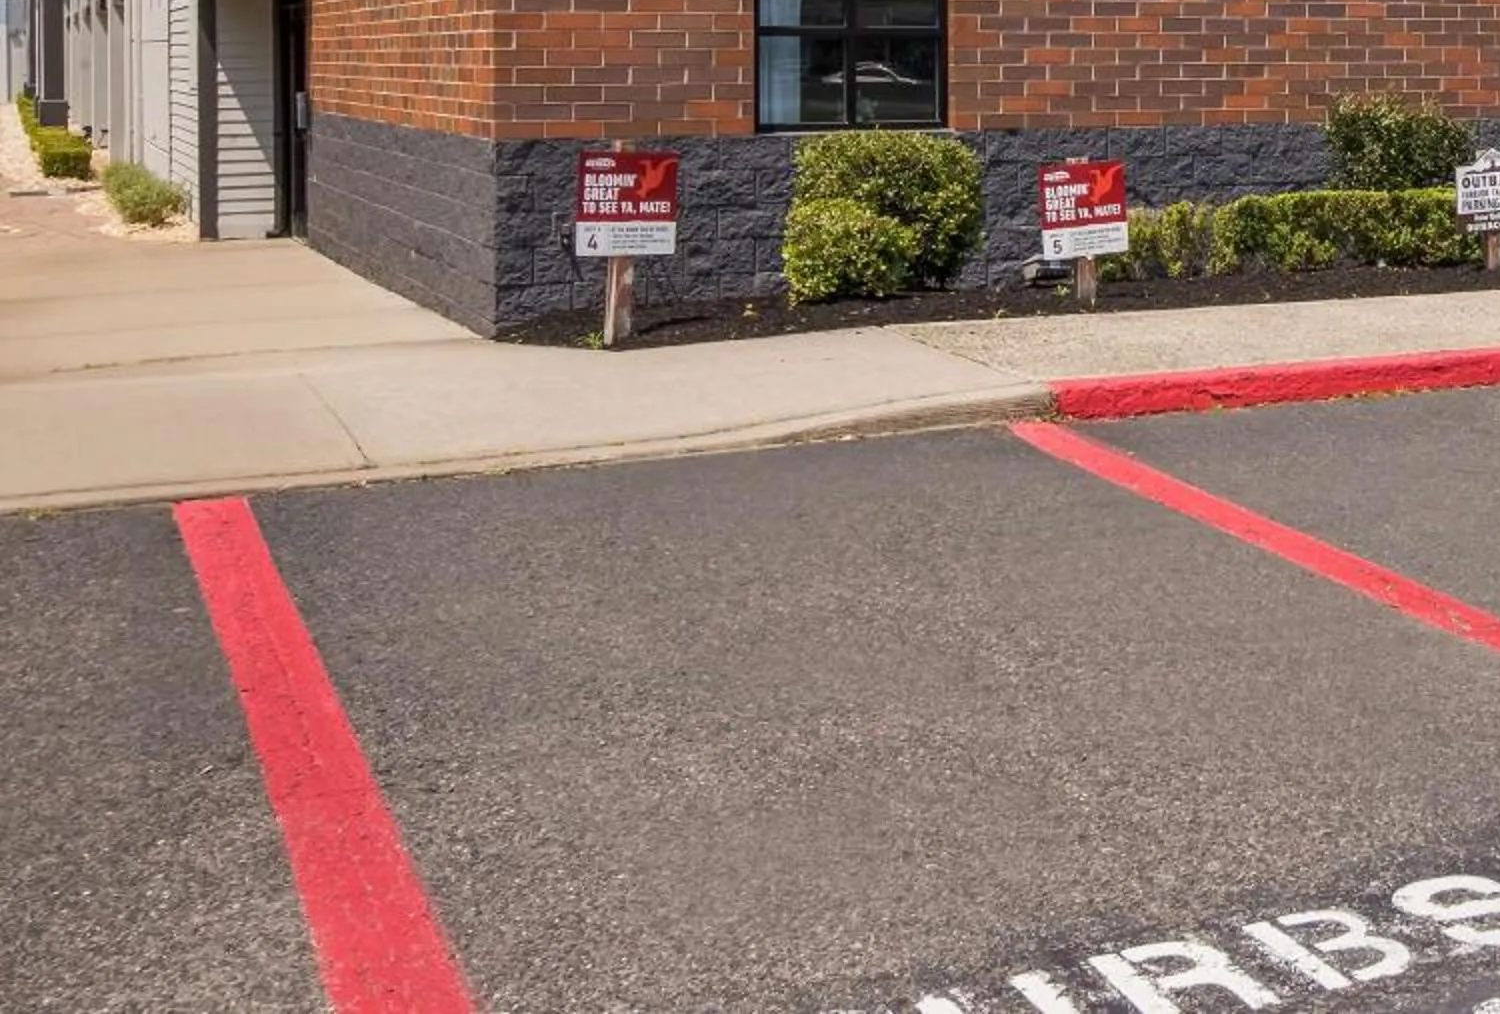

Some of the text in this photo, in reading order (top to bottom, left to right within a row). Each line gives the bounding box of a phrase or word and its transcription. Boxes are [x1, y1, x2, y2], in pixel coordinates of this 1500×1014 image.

[583, 187, 620, 201] GREAT
[582, 201, 597, 215] TO
[599, 201, 618, 215] SEE
[1045, 196, 1076, 210] GREAT
[587, 233, 598, 251] 4
[1053, 239, 1063, 255] 5
